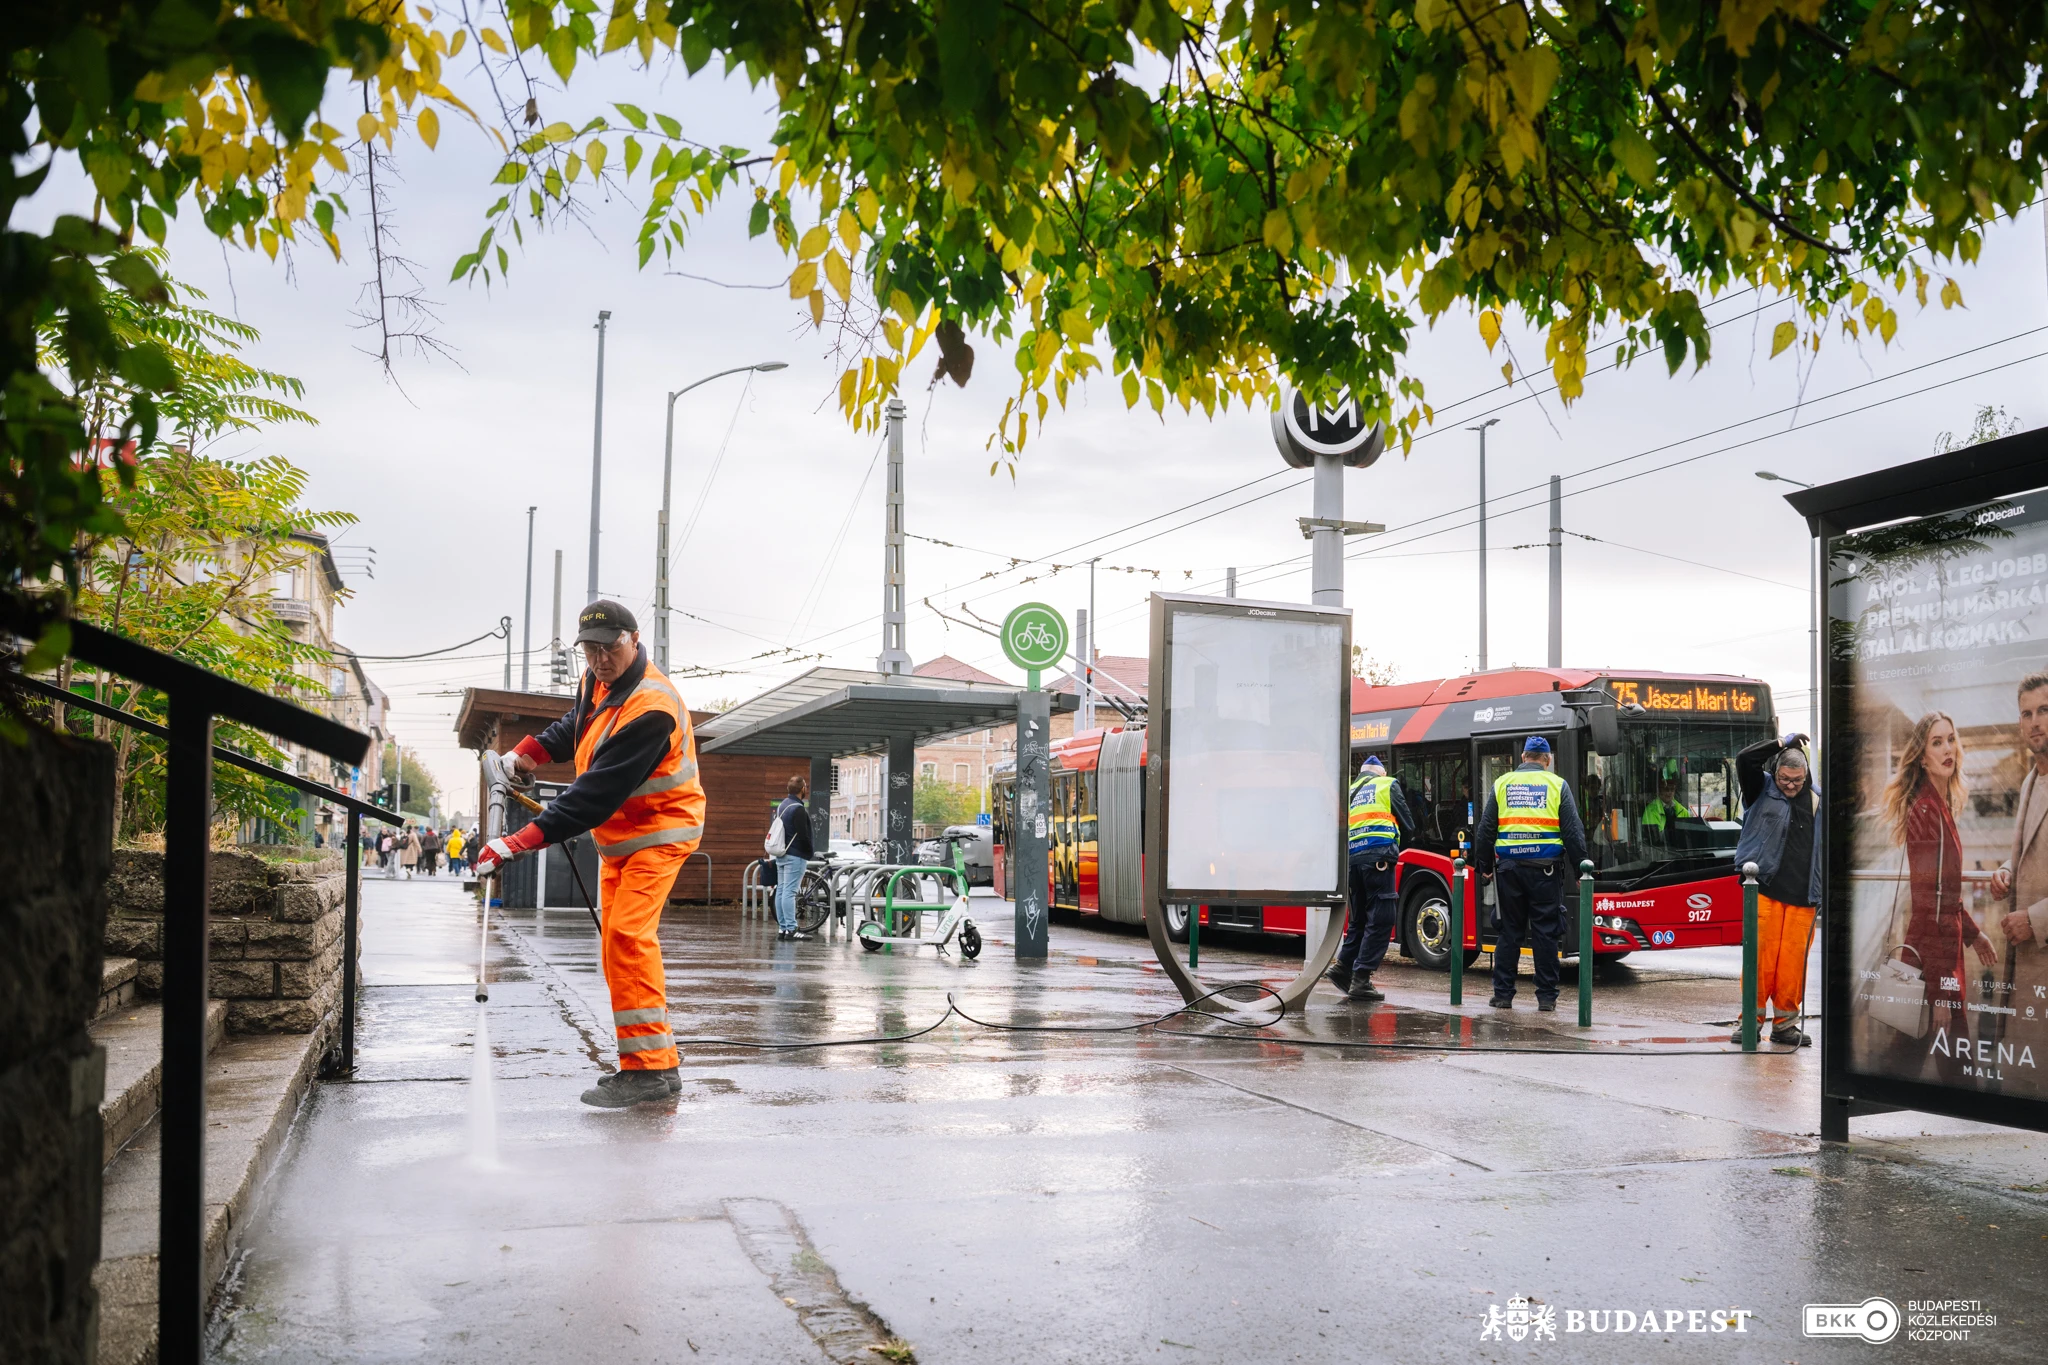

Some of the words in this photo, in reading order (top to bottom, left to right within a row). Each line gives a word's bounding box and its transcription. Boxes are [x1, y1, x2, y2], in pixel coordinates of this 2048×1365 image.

[1975, 504, 2025, 527] JCDecaux
[1867, 577, 1921, 602] AHOL
[1948, 553, 2048, 588] LEGJOBB
[1612, 681, 1638, 710] 75
[1642, 685, 1692, 710] Jászai
[1696, 687, 1727, 711] Mari
[1731, 689, 1755, 711] tér
[1616, 900, 1655, 908] BUDAPEST
[1688, 910, 1711, 922] 9127
[1860, 970, 1880, 979] BOSS
[1940, 977, 1960, 987] KARL
[1972, 980, 2018, 991] FUTUREAL
[1860, 993, 1886, 1001] TOMMY
[1895, 998, 1929, 1006] HILFIGER
[1935, 999, 1962, 1010] GUESS
[1930, 1026, 2036, 1068] ARENA
[1963, 1065, 2004, 1081] MALL
